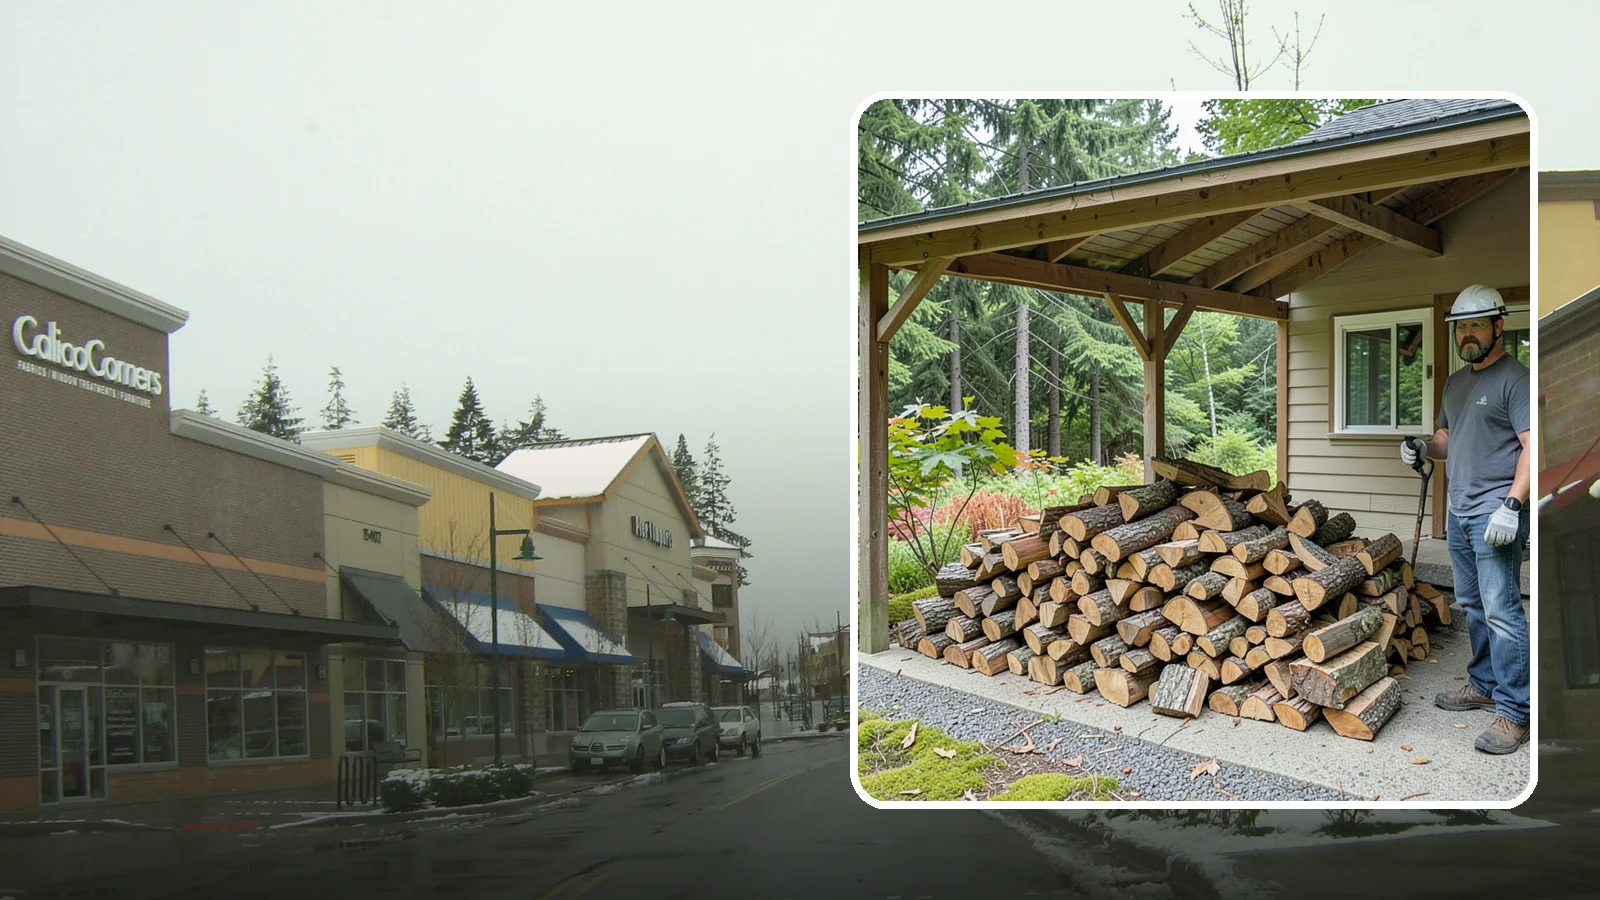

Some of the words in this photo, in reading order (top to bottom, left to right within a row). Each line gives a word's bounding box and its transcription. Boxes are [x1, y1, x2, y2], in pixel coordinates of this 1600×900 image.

[17, 360, 47, 377] FABRICS
[51, 370, 78, 386] WINDOW
[78, 378, 117, 398] TREATMENTS
[120, 390, 152, 408] FURNITURE
